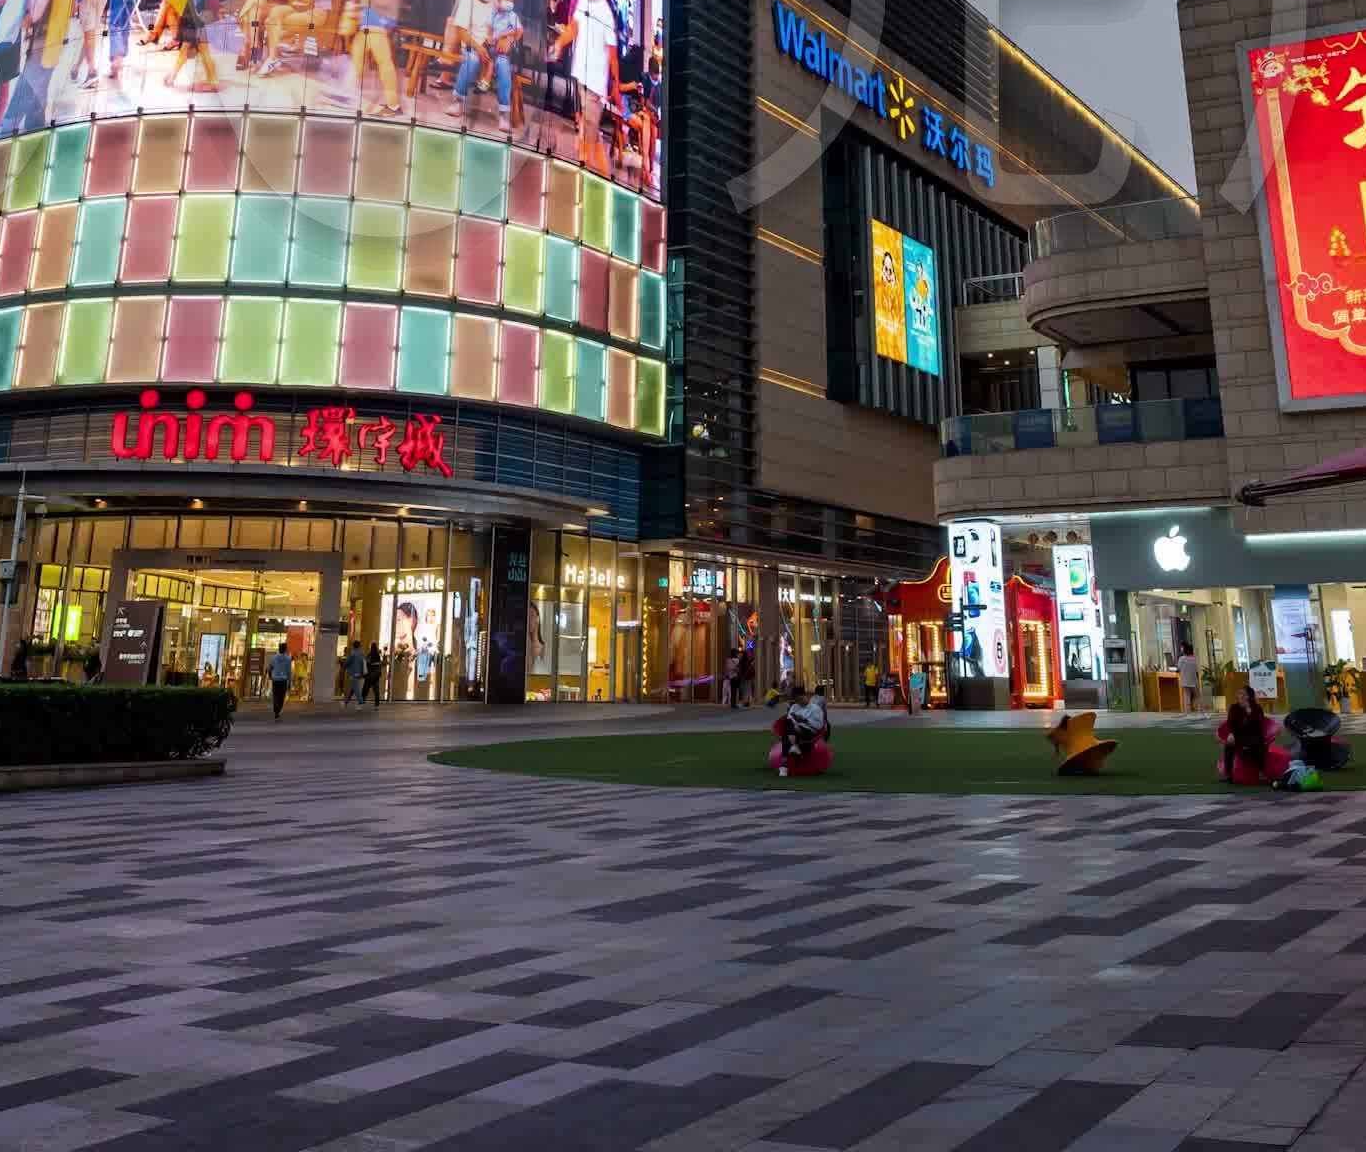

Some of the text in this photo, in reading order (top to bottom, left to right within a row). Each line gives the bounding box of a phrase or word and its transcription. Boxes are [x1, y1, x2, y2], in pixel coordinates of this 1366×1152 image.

[772, 0, 889, 121] Walmart
[921, 105, 995, 189] 沃尔玛
